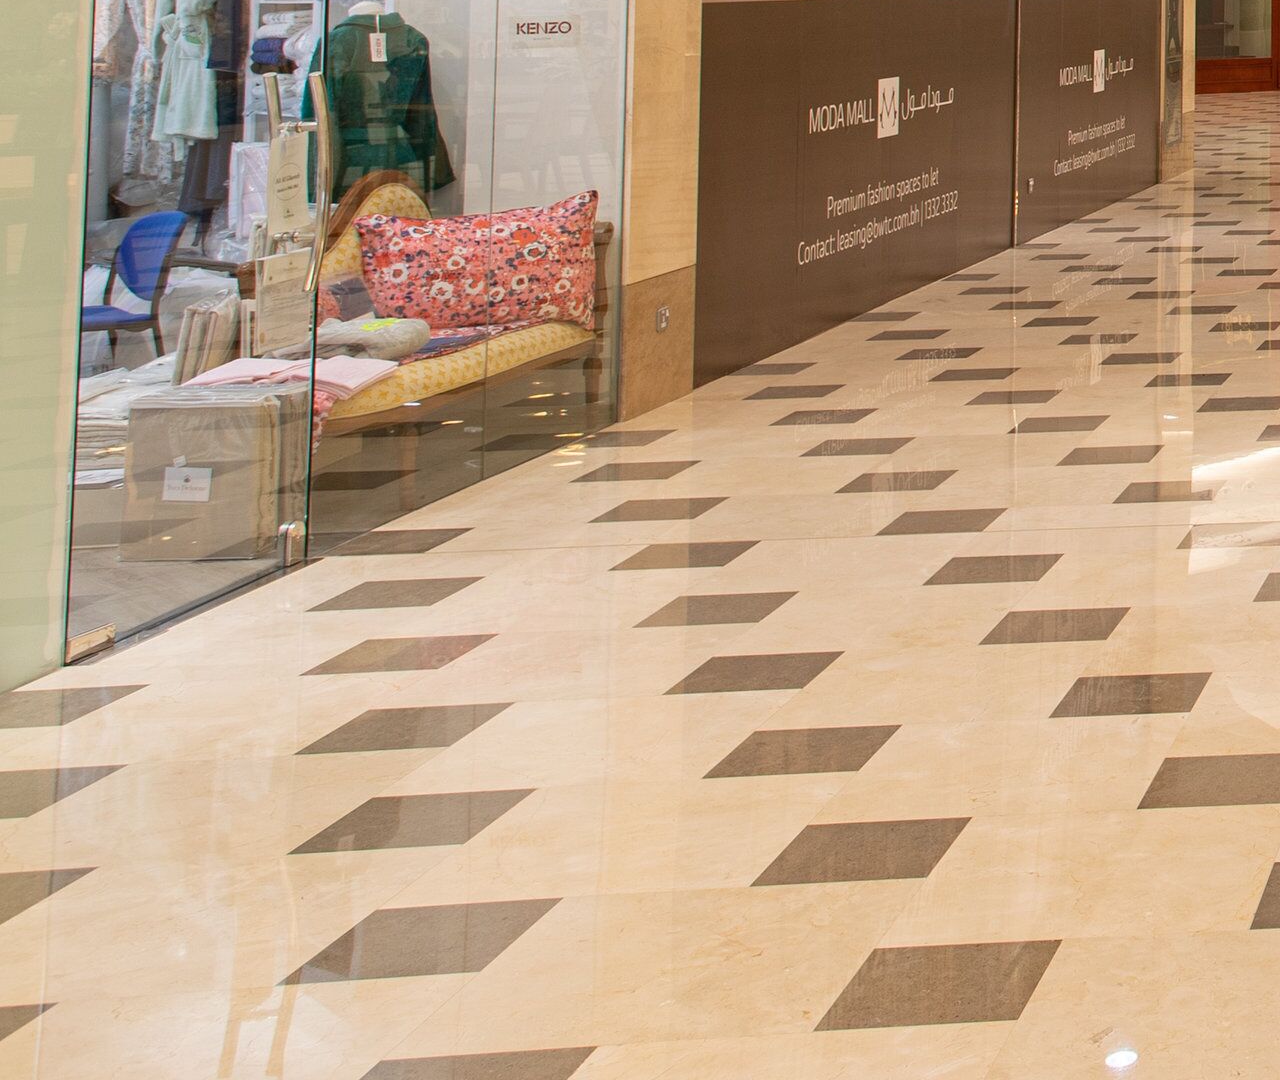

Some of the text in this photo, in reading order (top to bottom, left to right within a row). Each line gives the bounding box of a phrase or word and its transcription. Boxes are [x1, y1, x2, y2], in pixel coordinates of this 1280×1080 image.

[516, 21, 572, 35] KENZO
[1059, 63, 1092, 87] MODA MALL
[809, 98, 875, 134] MODA MALL
[901, 85, 954, 120] مودا مول
[1068, 126, 1088, 146] Premium
[1102, 121, 1116, 139] spaces
[827, 167, 939, 219] Premium fashion spaces to let
[797, 236, 836, 266] Contact:
[837, 204, 920, 253] leasing@bwtc.com.bh
[924, 196, 940, 220] 1332
[941, 190, 959, 215] 3332
